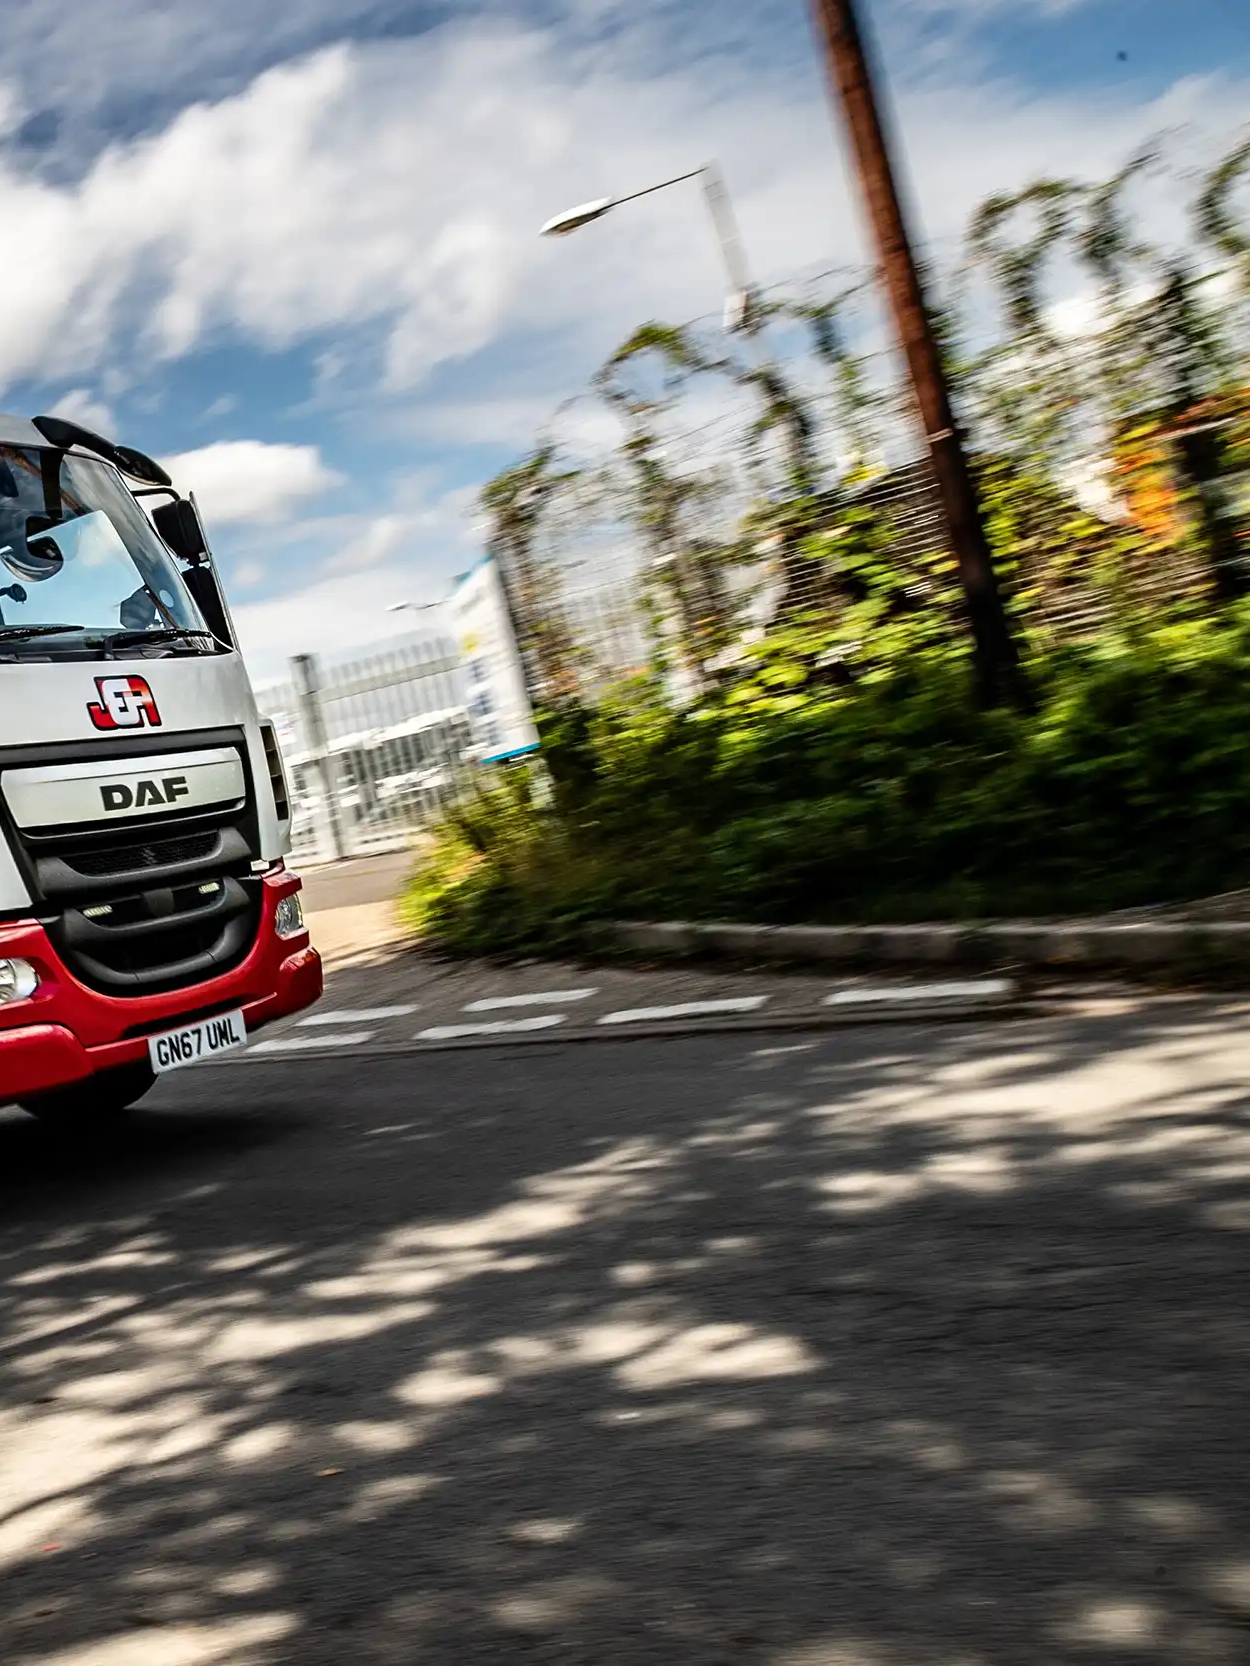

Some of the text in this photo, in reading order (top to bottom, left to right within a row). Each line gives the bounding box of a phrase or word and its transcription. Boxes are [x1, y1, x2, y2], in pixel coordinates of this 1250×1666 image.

[100, 776, 189, 812] DAF
[157, 1018, 240, 1067] GN67 UML
